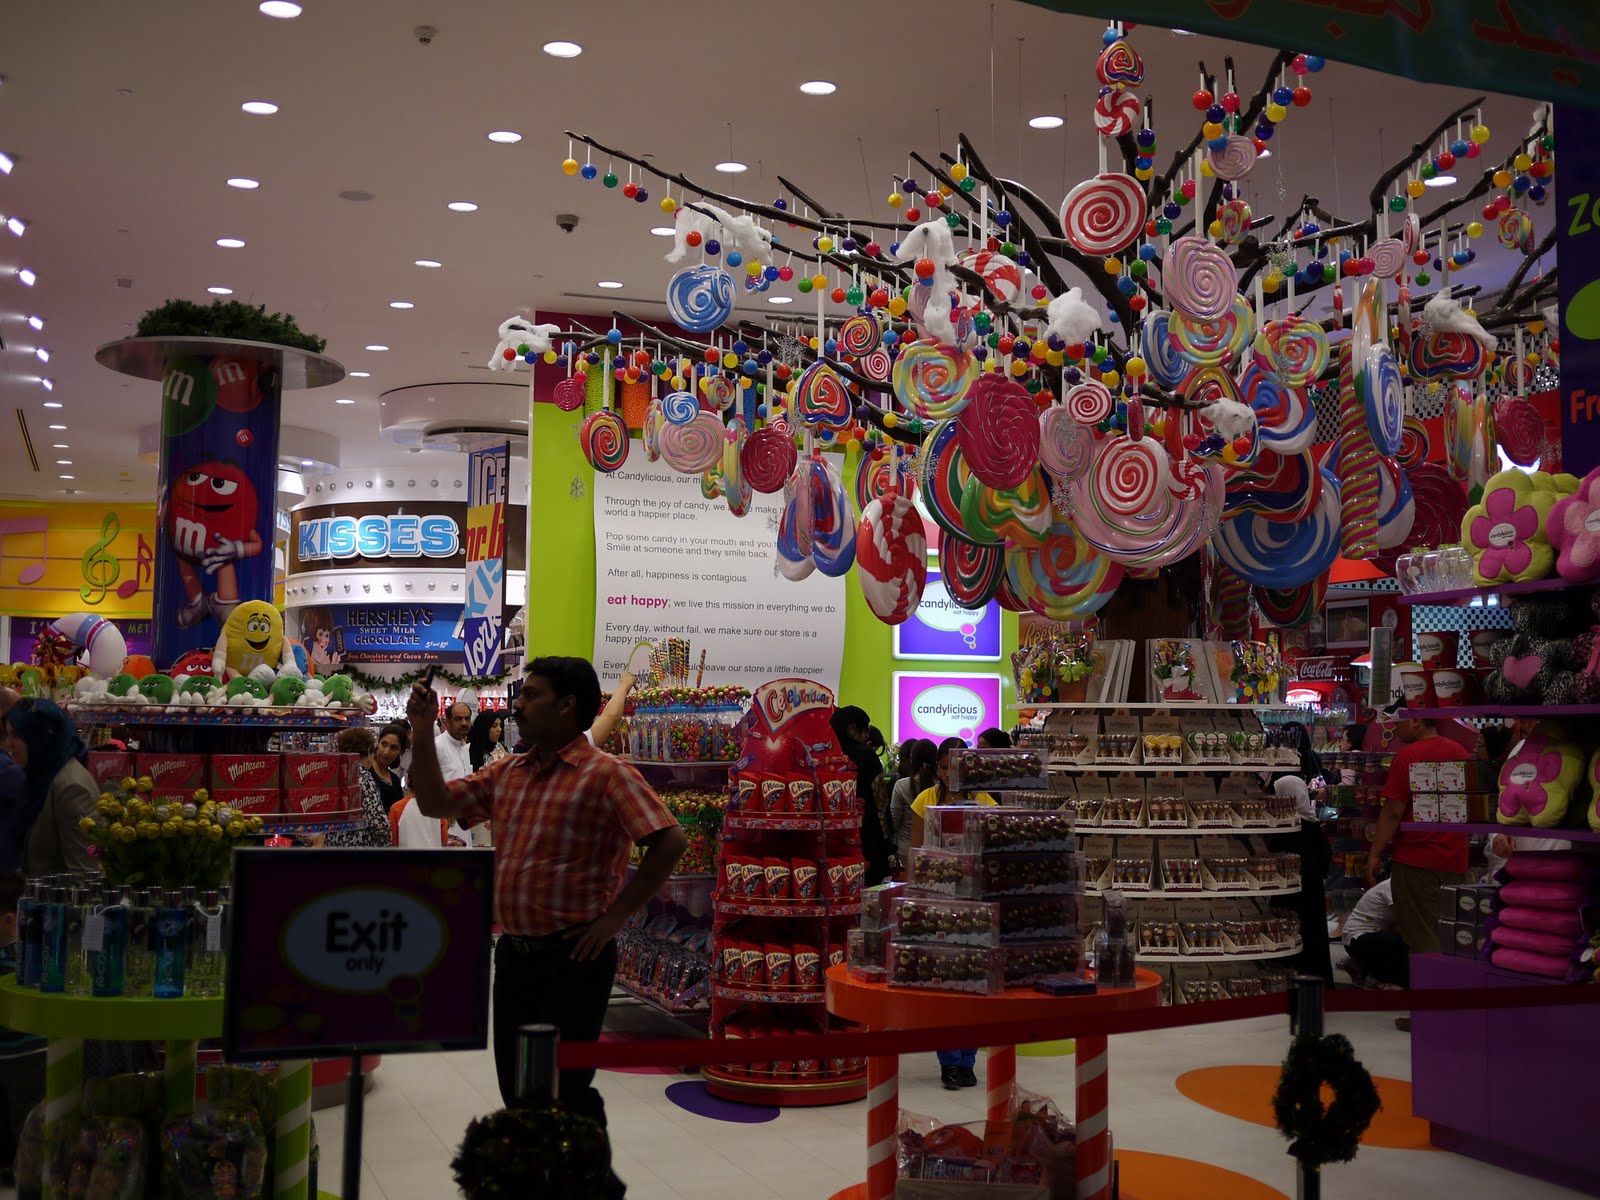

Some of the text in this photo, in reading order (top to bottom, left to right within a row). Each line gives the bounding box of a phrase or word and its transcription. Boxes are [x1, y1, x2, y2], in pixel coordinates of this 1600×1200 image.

[618, 471, 674, 483] Candylicious,
[605, 496, 641, 508] Through
[643, 499, 657, 507] the
[659, 501, 671, 510] joy
[674, 501, 682, 509] of
[684, 501, 712, 512] candy,
[755, 505, 777, 514] make
[605, 508, 628, 517] world
[638, 510, 670, 519] happier
[298, 515, 460, 561] KISSES
[606, 532, 624, 541] Pop
[626, 534, 650, 542] some
[652, 535, 678, 544] candy
[689, 537, 709, 546] your
[711, 539, 737, 547] mouth
[739, 540, 755, 548] and
[757, 541, 772, 549] you
[606, 542, 631, 552] Smile
[633, 544, 642, 552] at
[644, 545, 684, 555] someone
[686, 547, 702, 555] and
[704, 548, 722, 558] they
[724, 549, 746, 557] smile
[607, 568, 629, 577] After
[631, 570, 644, 579] all,
[645, 570, 690, 580] happiness
[692, 571, 700, 580] is
[607, 595, 627, 605] eat
[674, 600, 687, 608] we
[688, 600, 703, 609] live
[705, 600, 721, 609] this
[722, 601, 755, 610] mission
[756, 602, 764, 610] in
[766, 603, 809, 614] everything
[346, 607, 434, 626] HERSHEY'S
[128, 623, 150, 634] MET
[606, 622, 632, 633] Every
[633, 624, 651, 633] day,
[653, 625, 685, 634] without
[686, 625, 701, 634] fail,
[718, 626, 742, 635] make
[743, 628, 762, 636] sure
[764, 629, 778, 637] our
[780, 628, 801, 637] store
[802, 630, 810, 638] is
[811, 630, 817, 638] a
[354, 635, 421, 646] CHOCOLATE
[605, 634, 633, 644] happy
[389, 652, 402, 660] and
[403, 652, 422, 660] Cocoa
[744, 664, 765, 673] store
[774, 665, 791, 674] little
[793, 666, 824, 675] happier
[763, 686, 830, 723] Celebrations
[917, 704, 978, 716] candylicious
[150, 759, 186, 780] Maltesers
[227, 759, 266, 781] Maltesers
[297, 759, 335, 780] Maltesers
[300, 793, 330, 813] Maltesers
[326, 909, 408, 952] Exit
[345, 952, 384, 975] only
